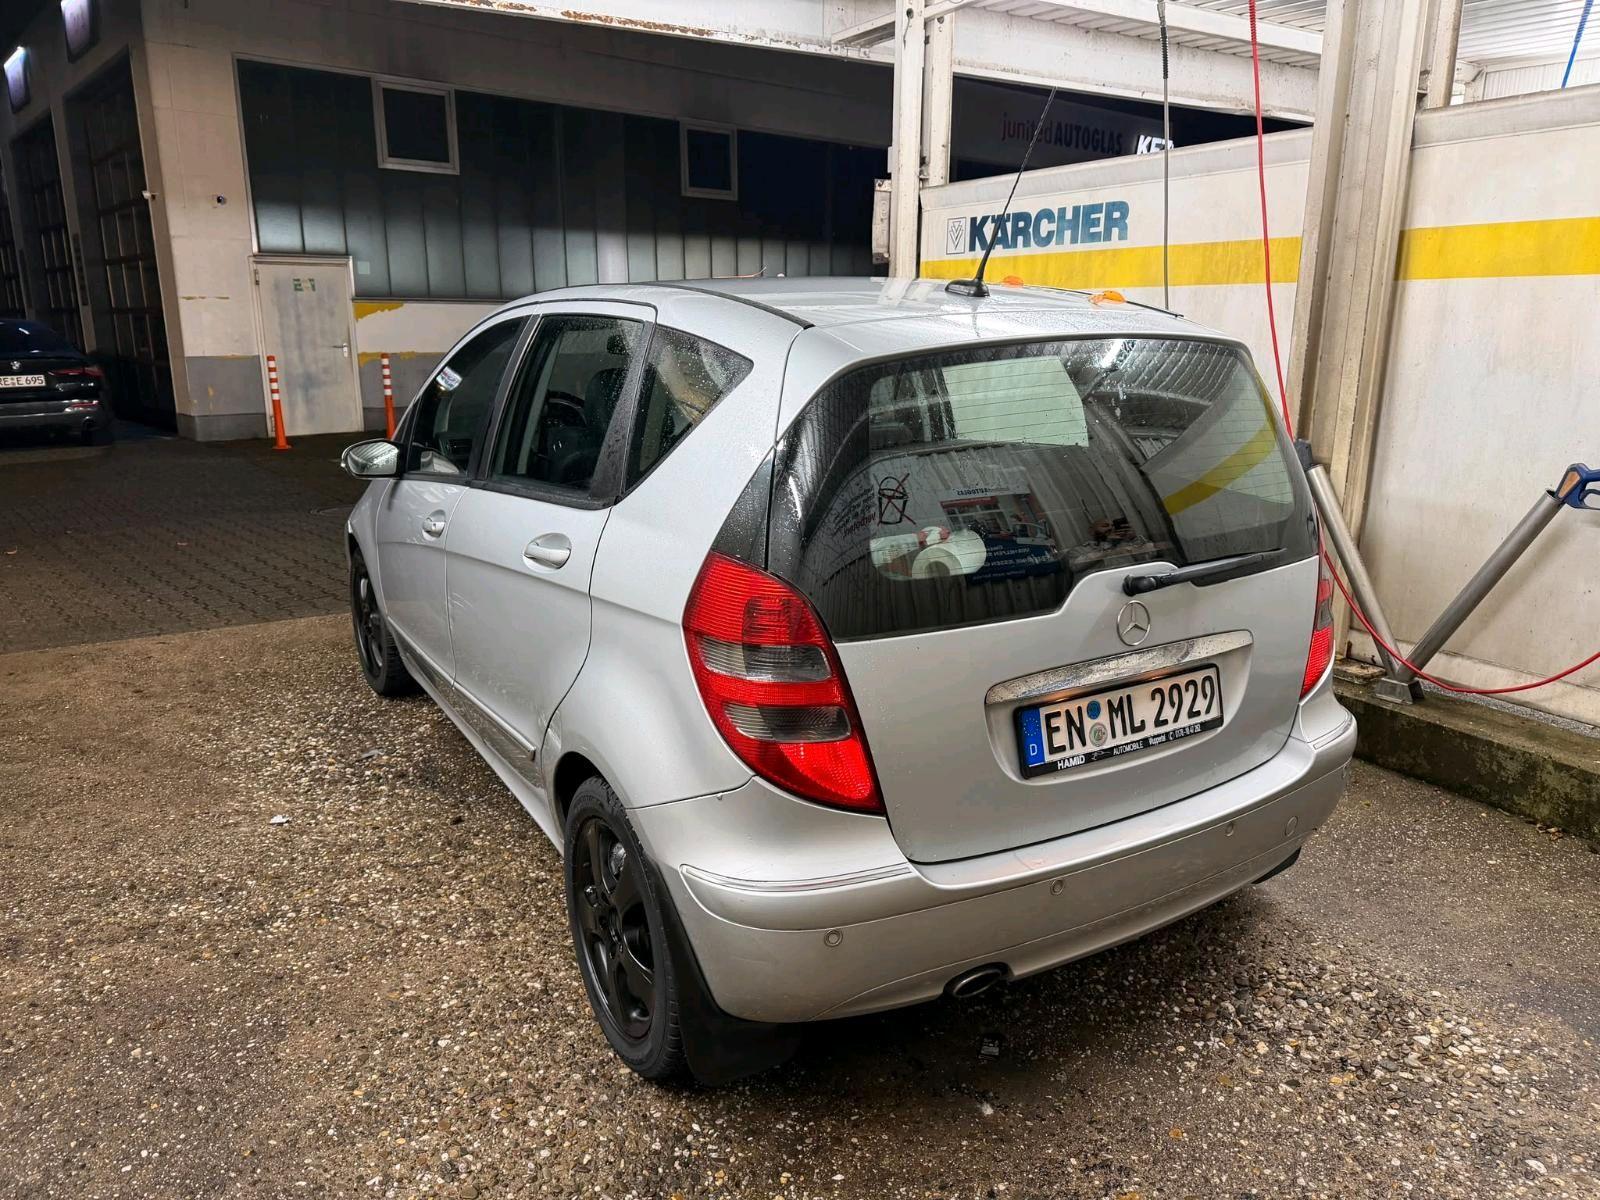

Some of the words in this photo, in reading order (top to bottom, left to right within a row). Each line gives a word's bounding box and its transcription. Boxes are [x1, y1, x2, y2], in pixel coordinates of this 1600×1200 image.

[969, 200, 1130, 252] KÄRCHER
[16, 376, 24, 386] E
[25, 376, 43, 385] 695
[1044, 706, 1087, 755] EN
[1106, 693, 1146, 739] ML
[1150, 675, 1215, 728] 2929
[1029, 743, 1038, 756] D
[1057, 754, 1086, 770] HAMID
[1113, 740, 1144, 756] AUTOMOBILE
